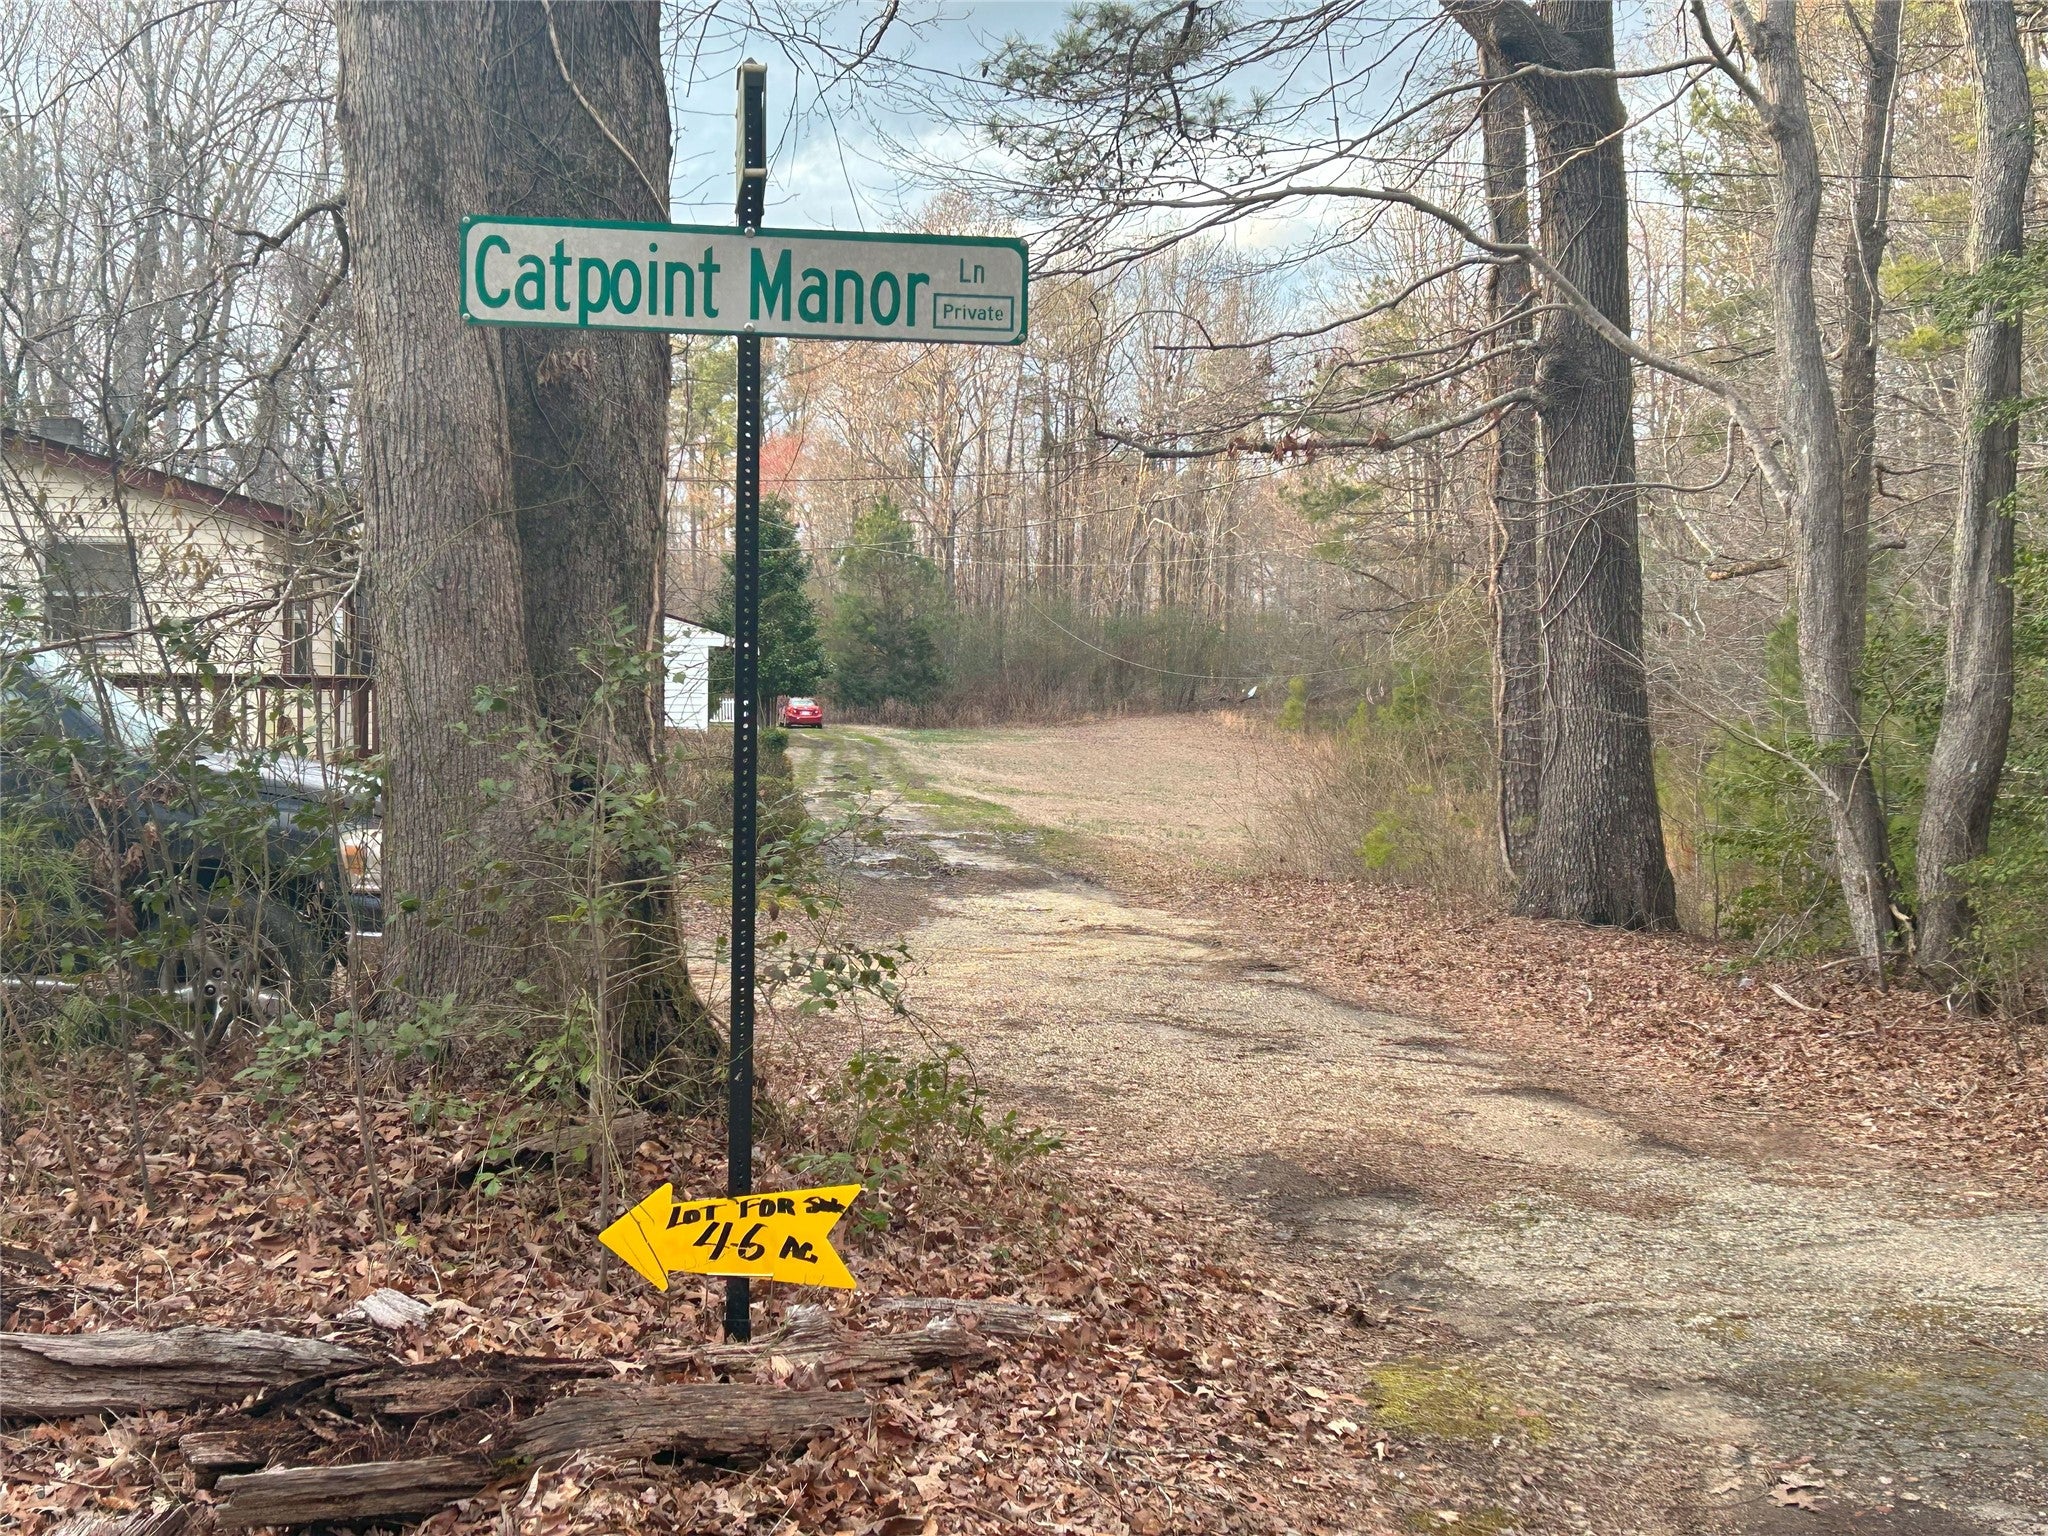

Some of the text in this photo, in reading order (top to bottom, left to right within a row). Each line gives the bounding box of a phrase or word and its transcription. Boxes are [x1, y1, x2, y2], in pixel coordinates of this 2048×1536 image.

[475, 234, 930, 327] Catpoint Manor
[959, 258, 985, 284] Ln
[943, 303, 1004, 321] Private
[666, 1204, 727, 1230] LOT
[739, 1197, 796, 1219] FOR
